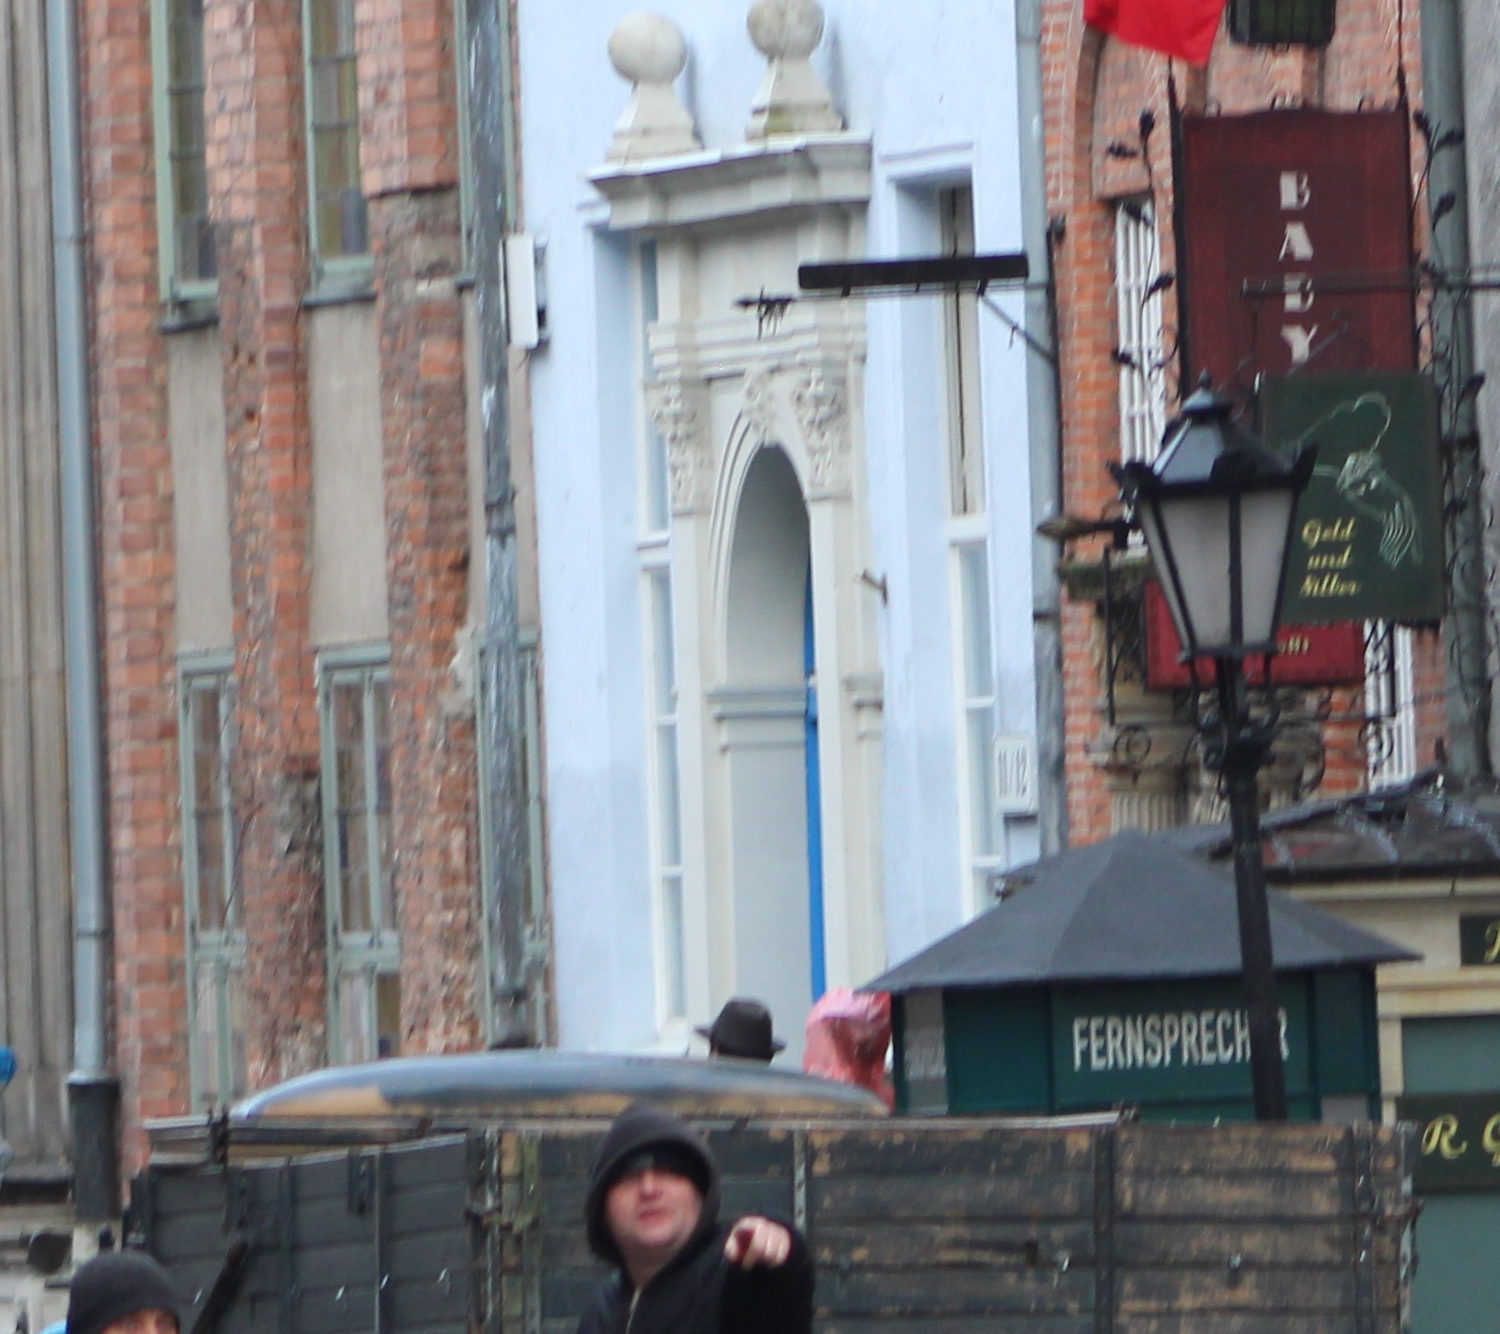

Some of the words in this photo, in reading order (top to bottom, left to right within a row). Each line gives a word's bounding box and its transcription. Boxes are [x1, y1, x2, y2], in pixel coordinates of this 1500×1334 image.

[1301, 517, 1357, 549] Gold
[1307, 544, 1353, 570] und
[1300, 571, 1363, 598] Silber
[1073, 1006, 1291, 1073] FERNSPRECHR
[1420, 1113, 1468, 1160] R
